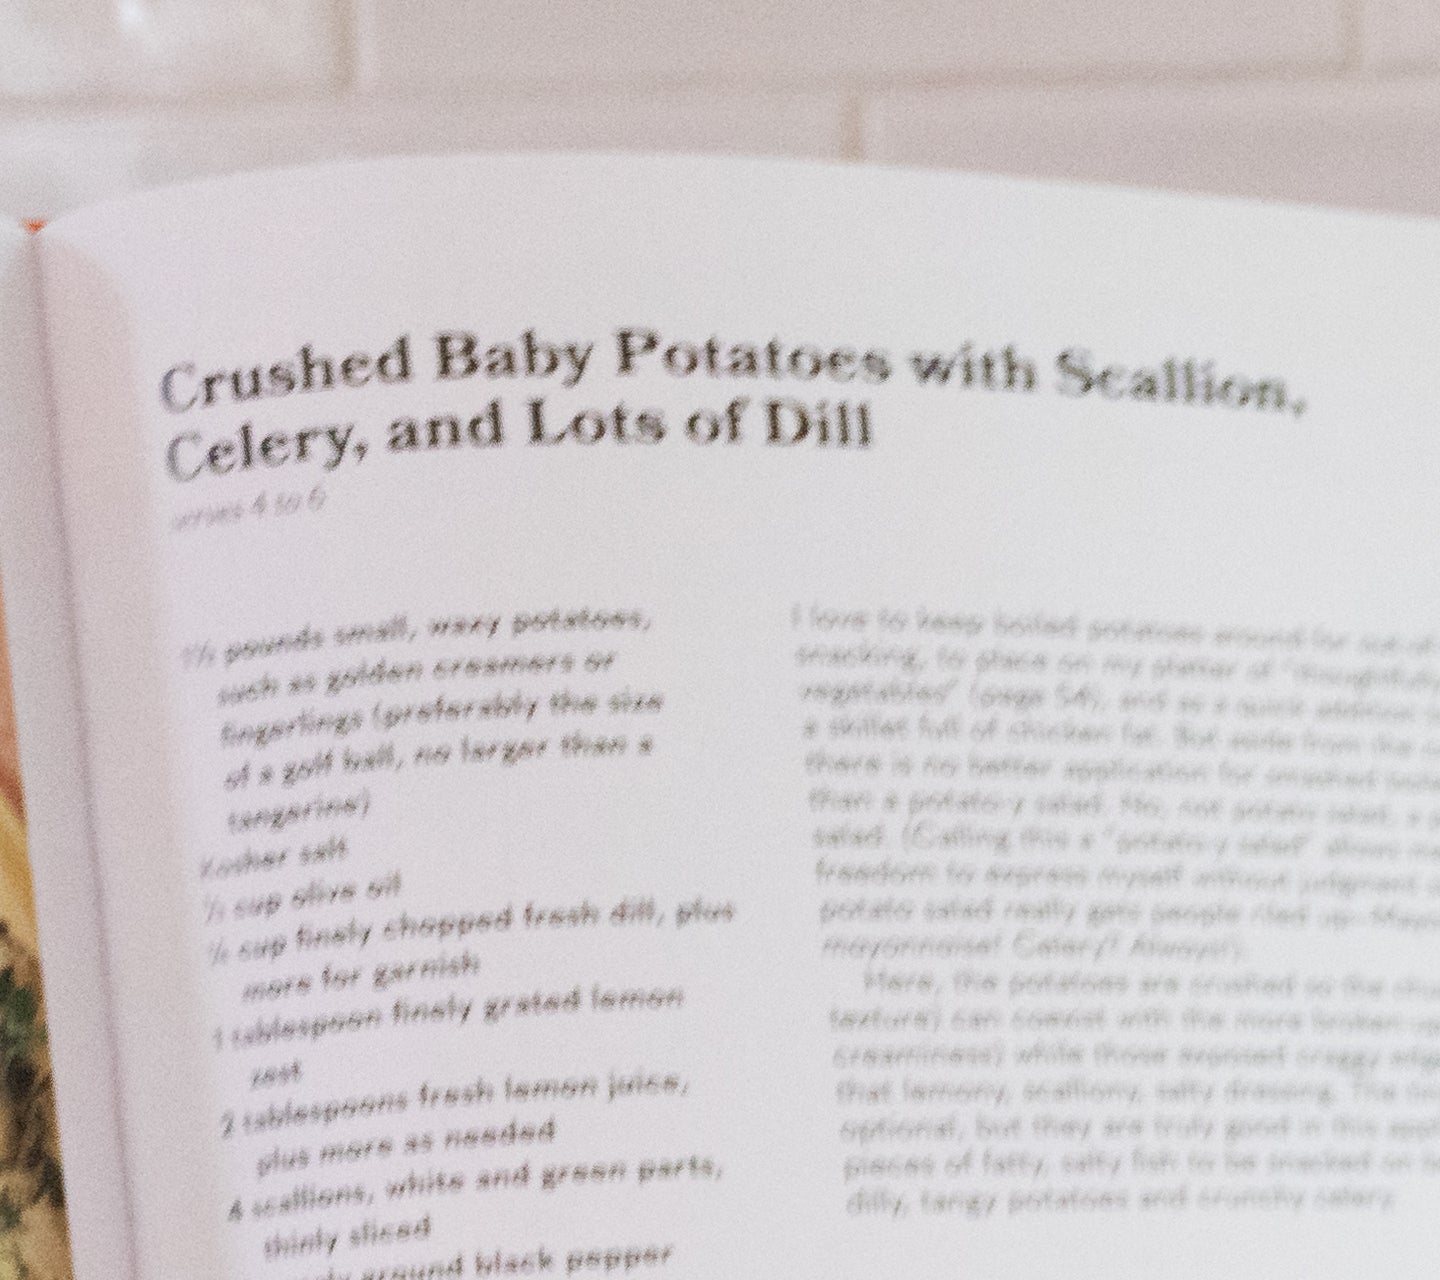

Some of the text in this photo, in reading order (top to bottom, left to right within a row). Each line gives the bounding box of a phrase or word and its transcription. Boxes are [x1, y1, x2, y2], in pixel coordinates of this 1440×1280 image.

[160, 329, 1307, 418] Crushed Baby Potatoes with Scallion,
[166, 399, 872, 482] Celery, and Lots of Dill
[224, 625, 324, 666] pounds
[334, 615, 416, 645] small,
[512, 609, 651, 636] potatoes,
[217, 653, 615, 706] such as golden creamers or
[220, 691, 664, 747] fingerlings (preferably the size
[224, 763, 250, 790] of
[283, 750, 333, 786] golf
[343, 744, 403, 772] ball,
[414, 746, 451, 764] no
[461, 738, 547, 766] larger
[560, 733, 627, 756] than
[228, 793, 371, 832] tangerine)
[300, 837, 348, 864] salt
[234, 895, 282, 917] cup
[291, 882, 356, 908] olive
[367, 871, 402, 898] oil
[238, 937, 287, 960] cup
[296, 921, 372, 947] finely
[383, 906, 513, 939] chopped
[523, 901, 599, 927] fresh
[610, 898, 664, 926] dill,
[675, 897, 736, 928] plus
[242, 952, 480, 1001] more for garnish
[231, 1011, 382, 1047] tablespoon
[392, 996, 472, 1023] finely
[484, 987, 582, 1022] grated
[591, 985, 685, 1010] lemon
[243, 1093, 408, 1132] tablespoons
[418, 1078, 494, 1106] fresh
[504, 1077, 598, 1100] lemon
[608, 1074, 689, 1102] juice,
[251, 1061, 302, 1089] zest
[256, 1118, 556, 1178] plus more as needed
[252, 1186, 373, 1217] scallions,
[386, 1173, 464, 1198] white
[477, 1163, 530, 1189] and
[541, 1163, 626, 1190] green
[637, 1155, 723, 1184] parts,
[264, 1215, 432, 1259] thinly sliced
[475, 1247, 553, 1275] black
[566, 1246, 672, 1274] pepper
